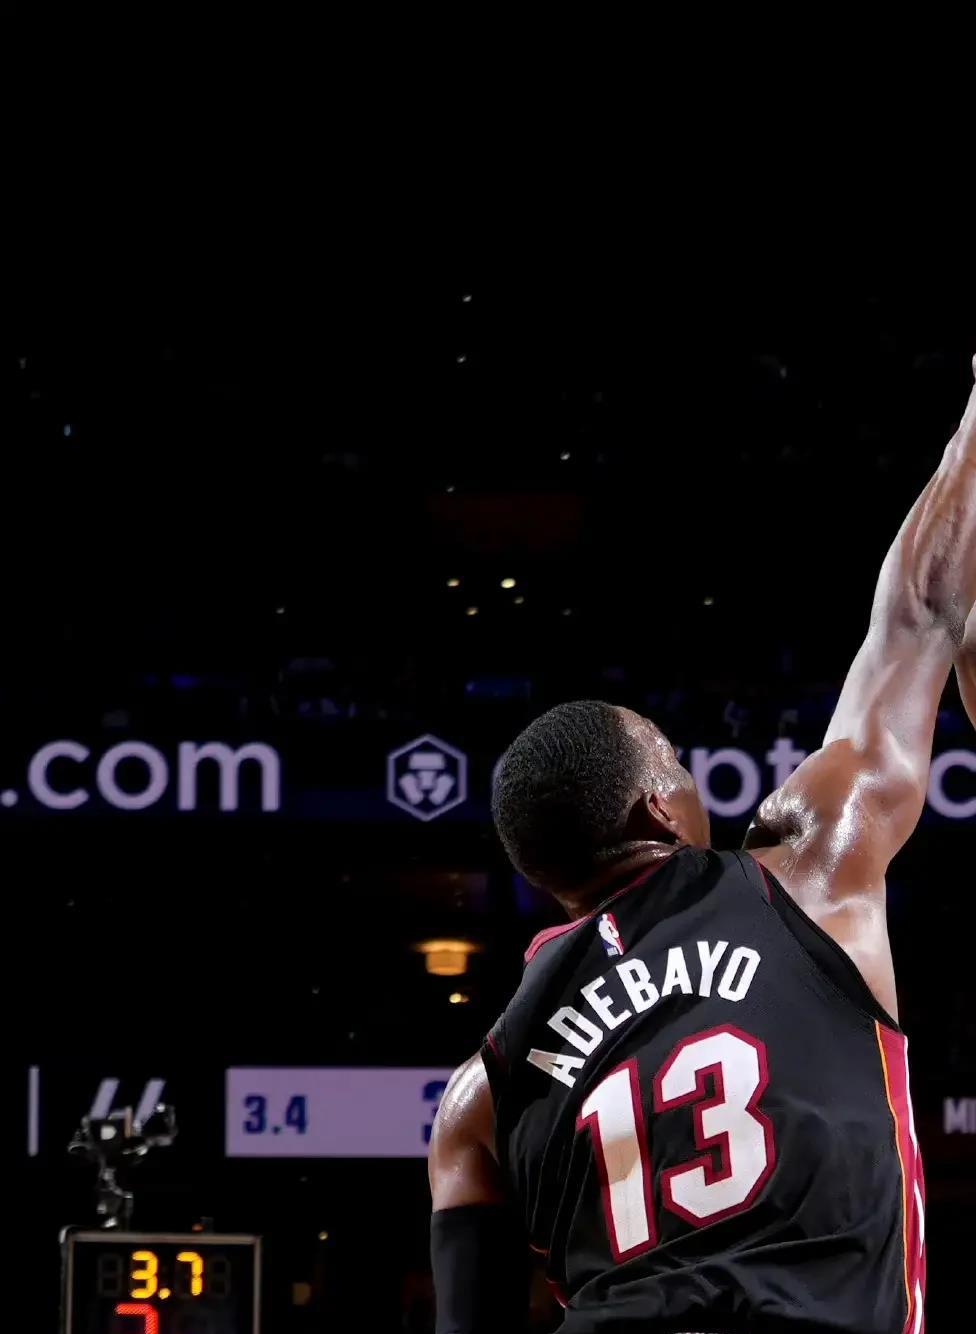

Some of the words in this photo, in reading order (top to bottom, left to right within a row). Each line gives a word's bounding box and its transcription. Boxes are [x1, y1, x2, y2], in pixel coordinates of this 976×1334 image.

[526, 940, 761, 1089] ADEBAYO
[243, 1094, 309, 1136] 3.4
[576, 1023, 776, 1264] 13
[130, 1250, 204, 1300] 3.7
